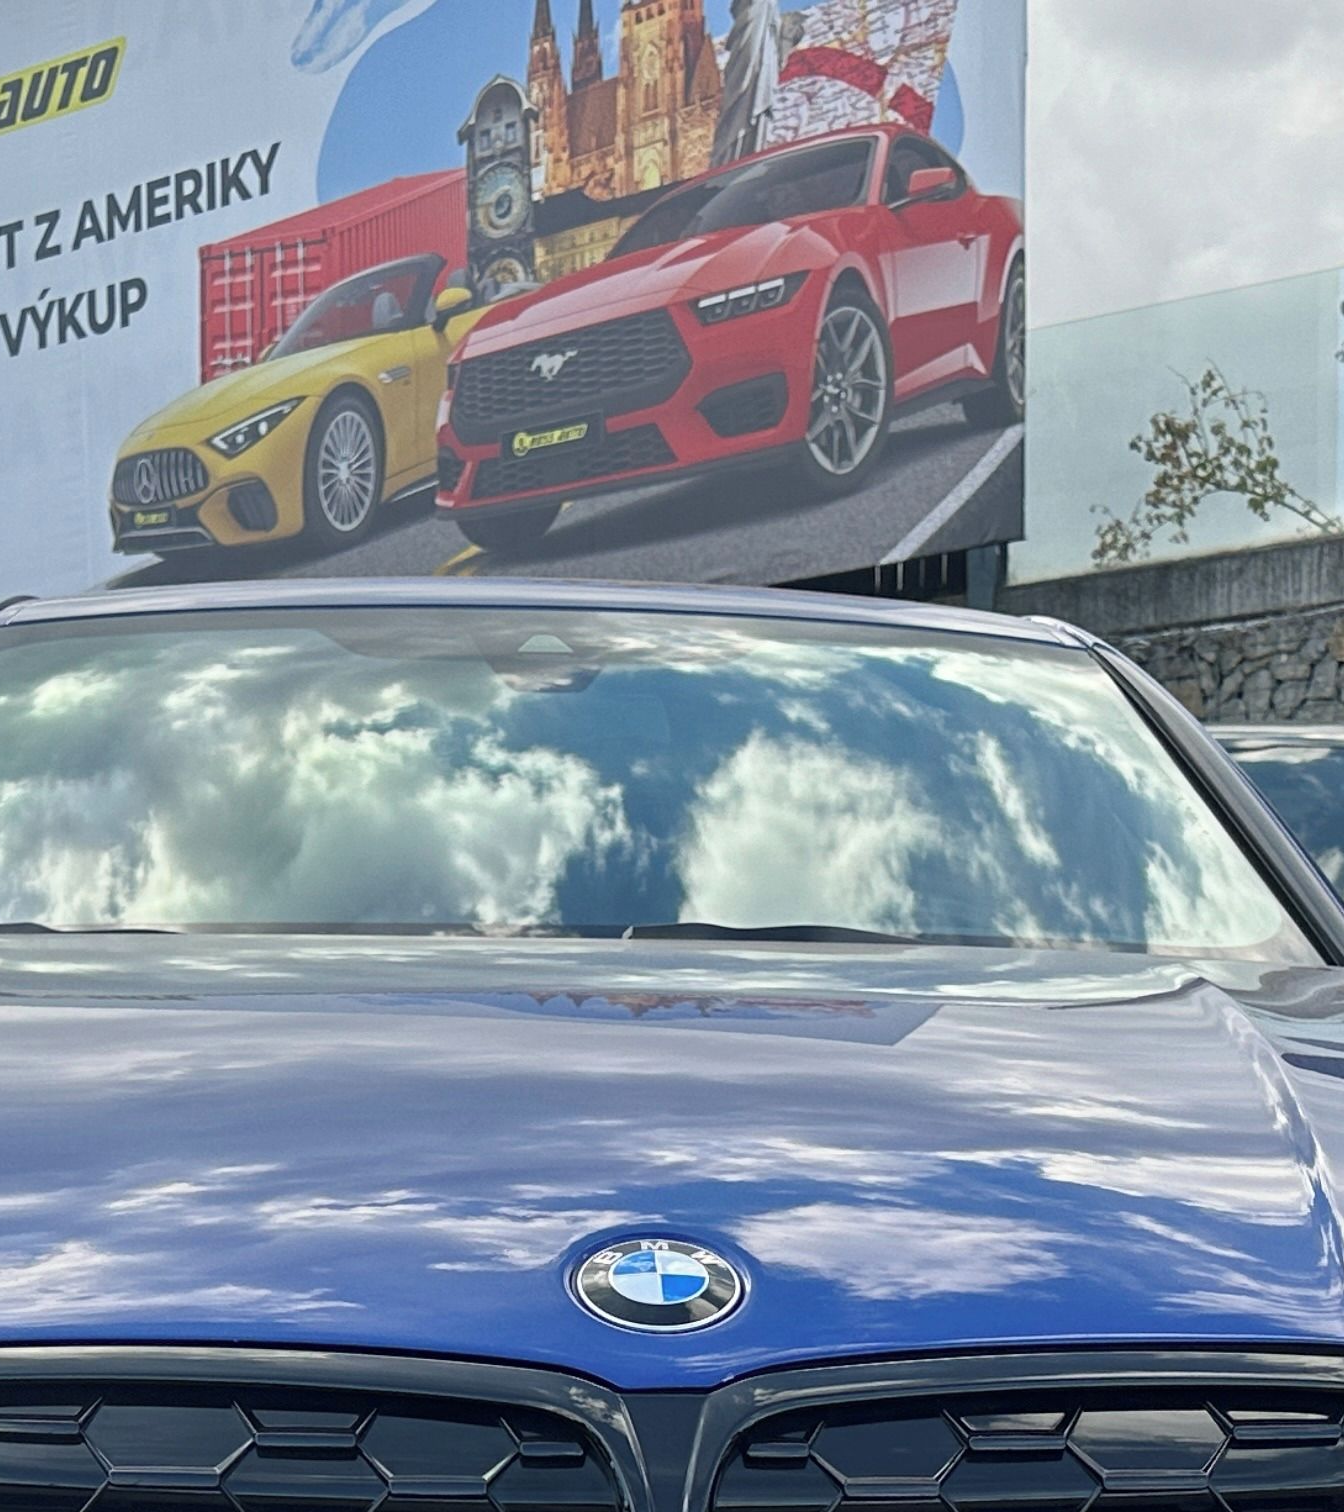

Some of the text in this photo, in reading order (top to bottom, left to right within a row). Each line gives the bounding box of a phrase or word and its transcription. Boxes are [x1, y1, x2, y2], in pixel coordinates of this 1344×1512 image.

[35, 209, 61, 261] Z
[72, 142, 281, 251] AMERIKY
[592, 1240, 728, 1269] BMW
